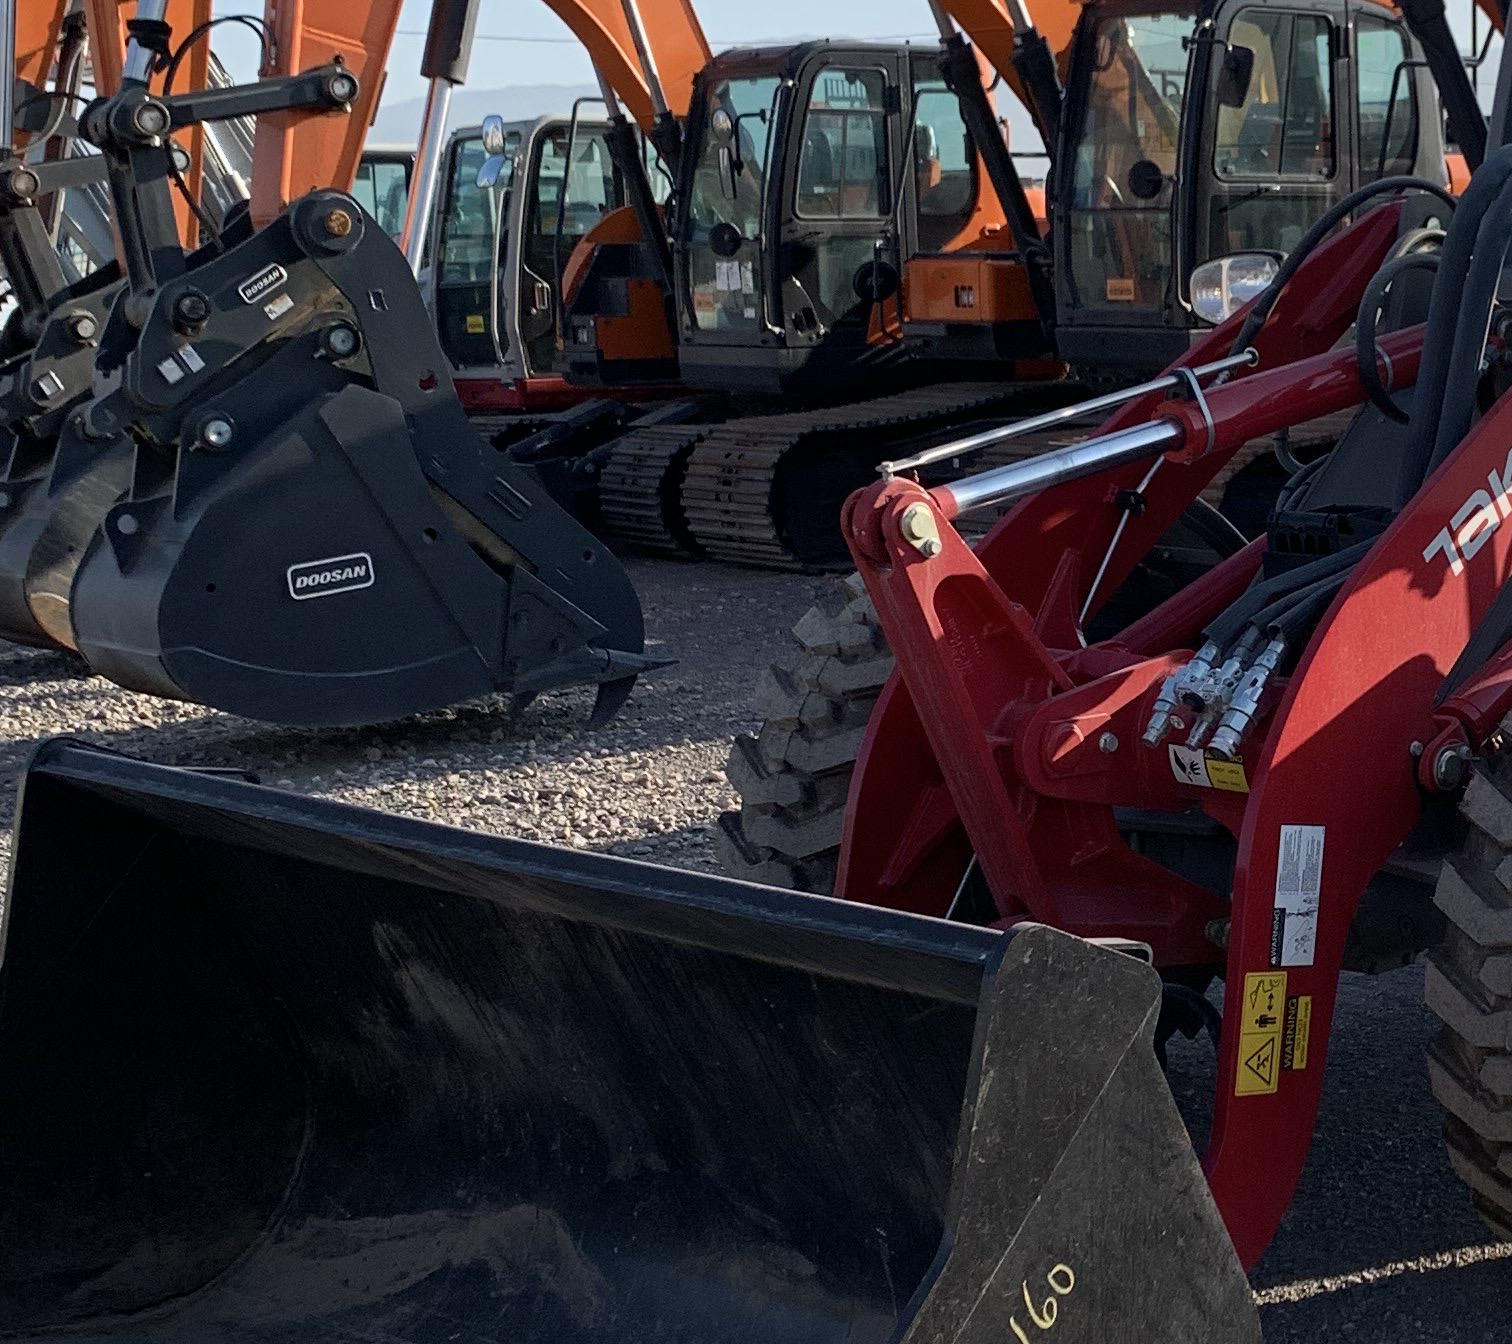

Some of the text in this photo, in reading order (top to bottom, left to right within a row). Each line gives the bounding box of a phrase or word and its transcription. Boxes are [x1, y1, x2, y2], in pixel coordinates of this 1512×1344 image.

[244, 268, 281, 299] DOOSAN
[295, 564, 367, 589] DOOSAN
[1283, 998, 1297, 1068] WARNING
